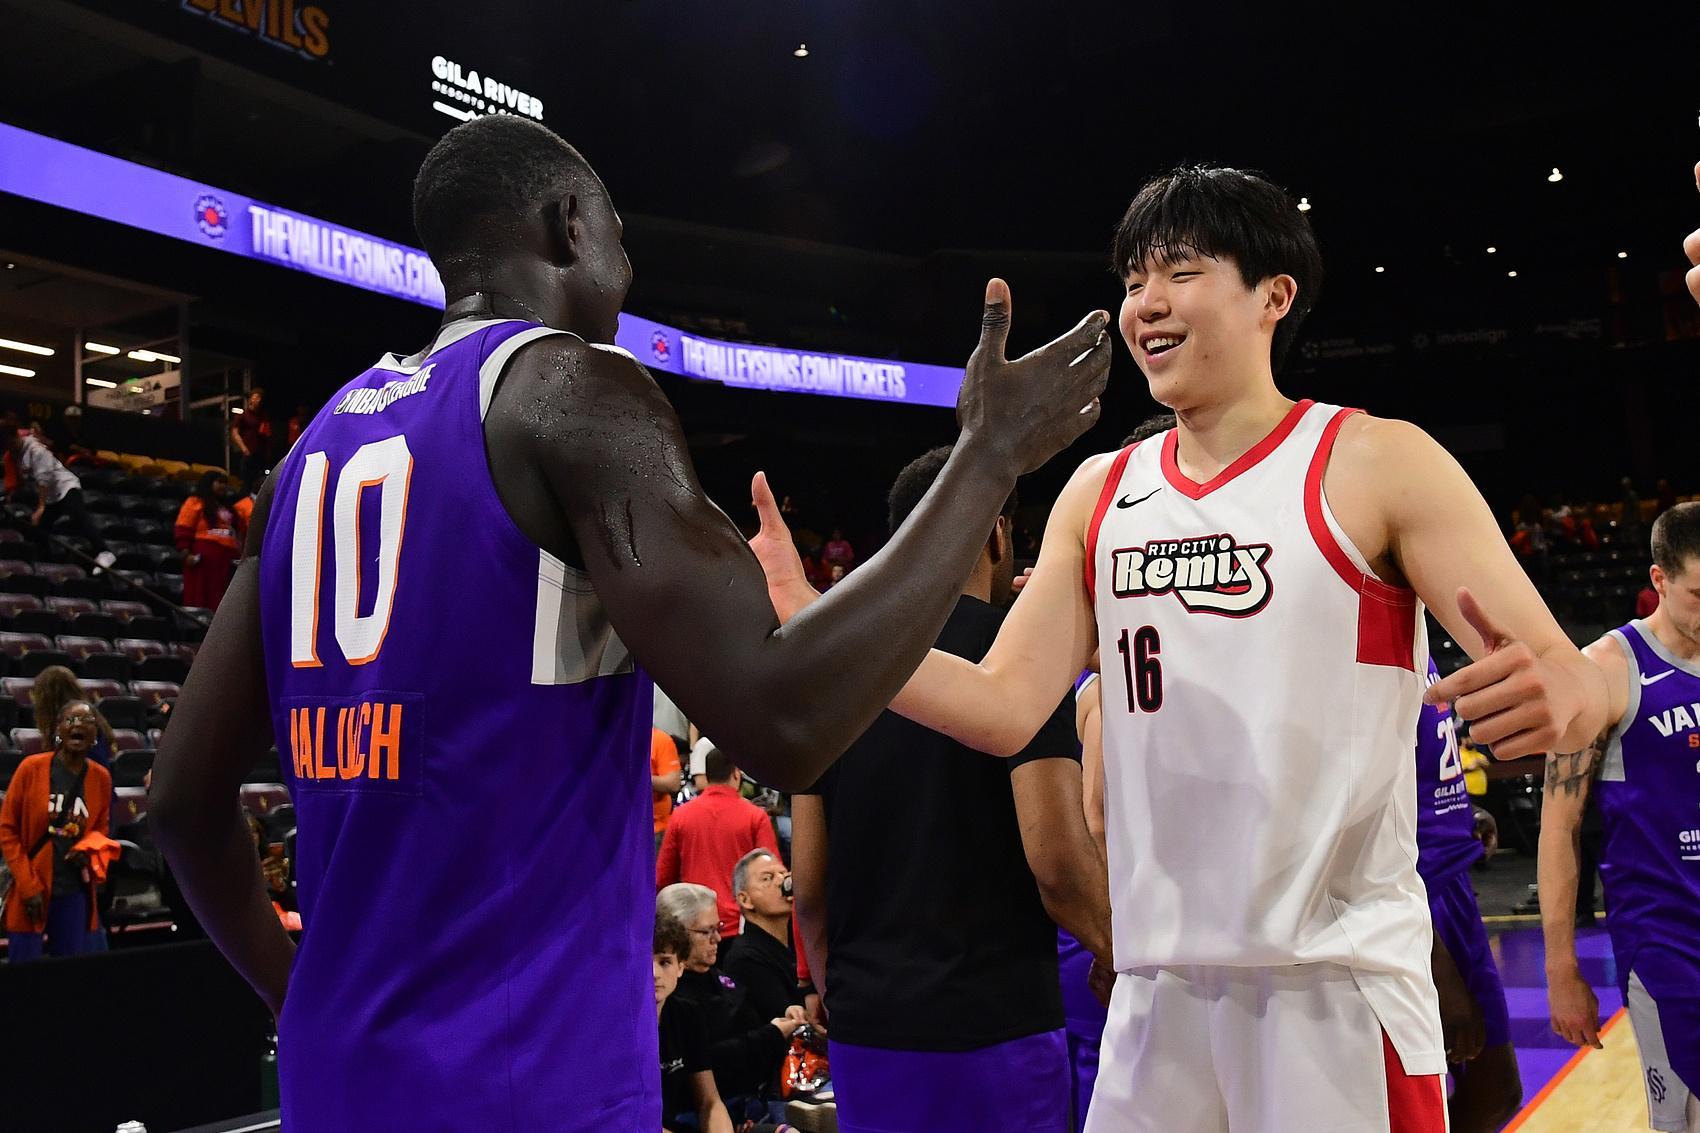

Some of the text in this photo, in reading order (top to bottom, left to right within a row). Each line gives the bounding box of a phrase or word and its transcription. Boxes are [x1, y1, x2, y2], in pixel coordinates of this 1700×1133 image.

[184, 0, 331, 58] VILS
[432, 55, 544, 120] GILA RIVER
[680, 336, 906, 398] THEVALLEYSUNS.COM/TICKETS
[291, 435, 414, 668] 10
[1114, 536, 1270, 614] Remix
[1148, 539, 1216, 556] RIP CITY
[1117, 625, 1164, 713] 16
